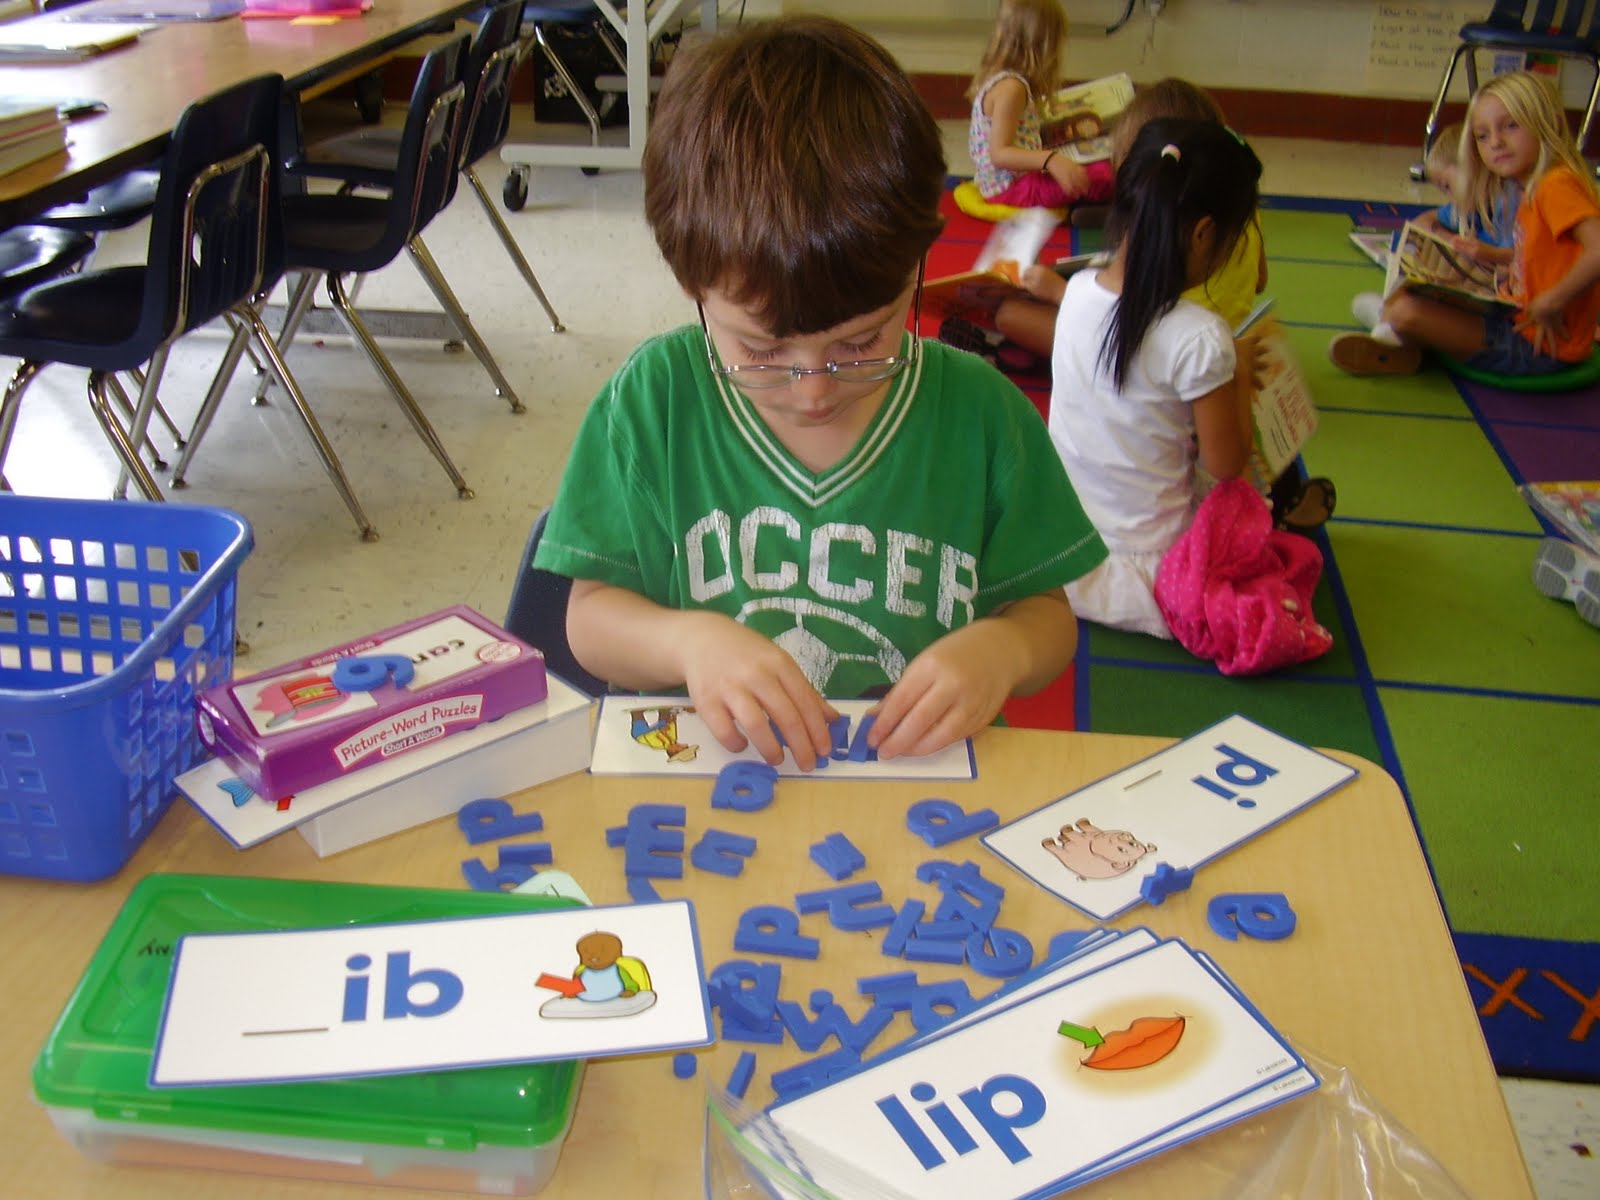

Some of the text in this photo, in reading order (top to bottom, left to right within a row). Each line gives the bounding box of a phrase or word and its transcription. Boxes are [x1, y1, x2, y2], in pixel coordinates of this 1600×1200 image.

[340, 701, 477, 761] Picture-Word Puzzles
[384, 727, 442, 754] Short A Words
[875, 1071, 1047, 1173] lip
